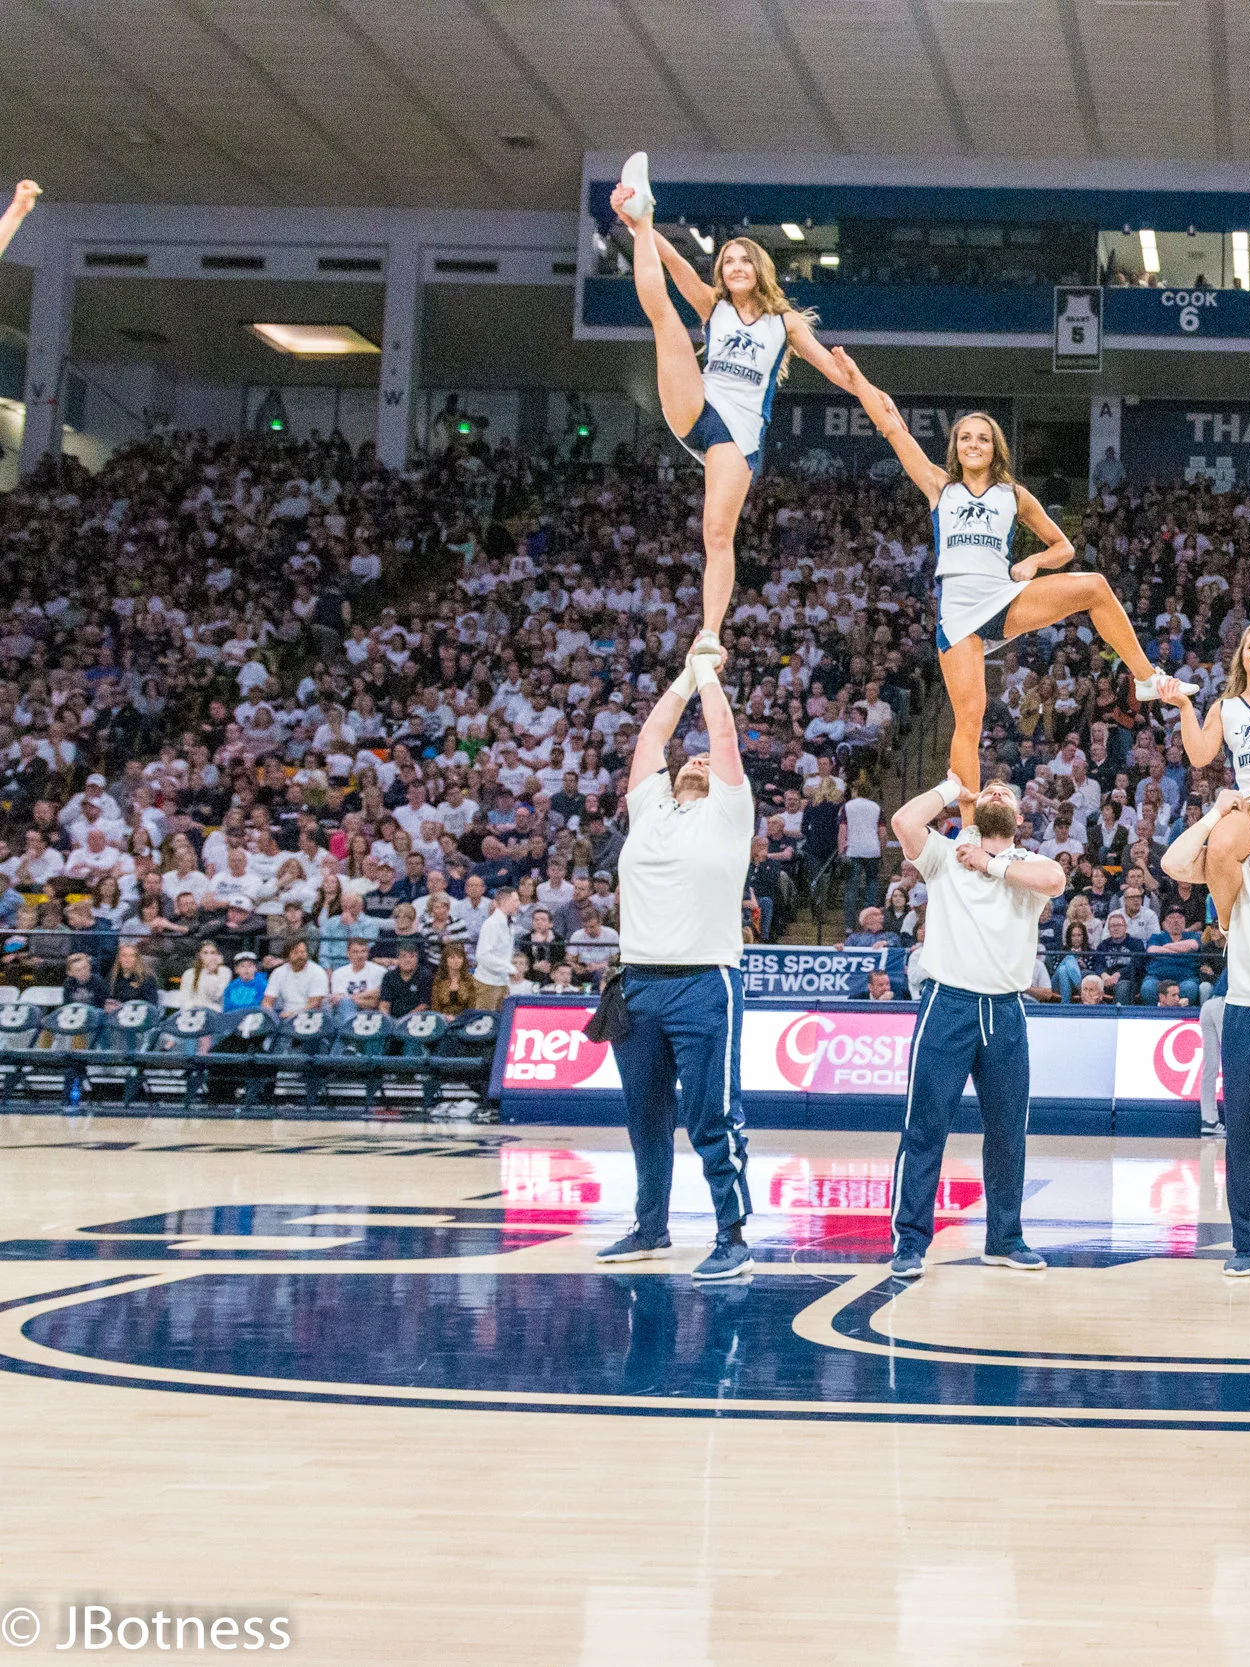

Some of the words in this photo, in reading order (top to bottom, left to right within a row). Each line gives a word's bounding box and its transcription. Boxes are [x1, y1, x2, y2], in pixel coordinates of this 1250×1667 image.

[1161, 291, 1218, 307] COOK
[1179, 306, 1200, 332] 6
[1071, 326, 1085, 344] 5
[1099, 402, 1114, 419] A
[792, 406, 803, 436] I
[947, 534, 972, 549] UTAH
[973, 534, 1003, 552] STATE
[740, 954, 779, 973] CBS
[784, 955, 876, 973] SPORTS
[510, 1028, 589, 1061] ner
